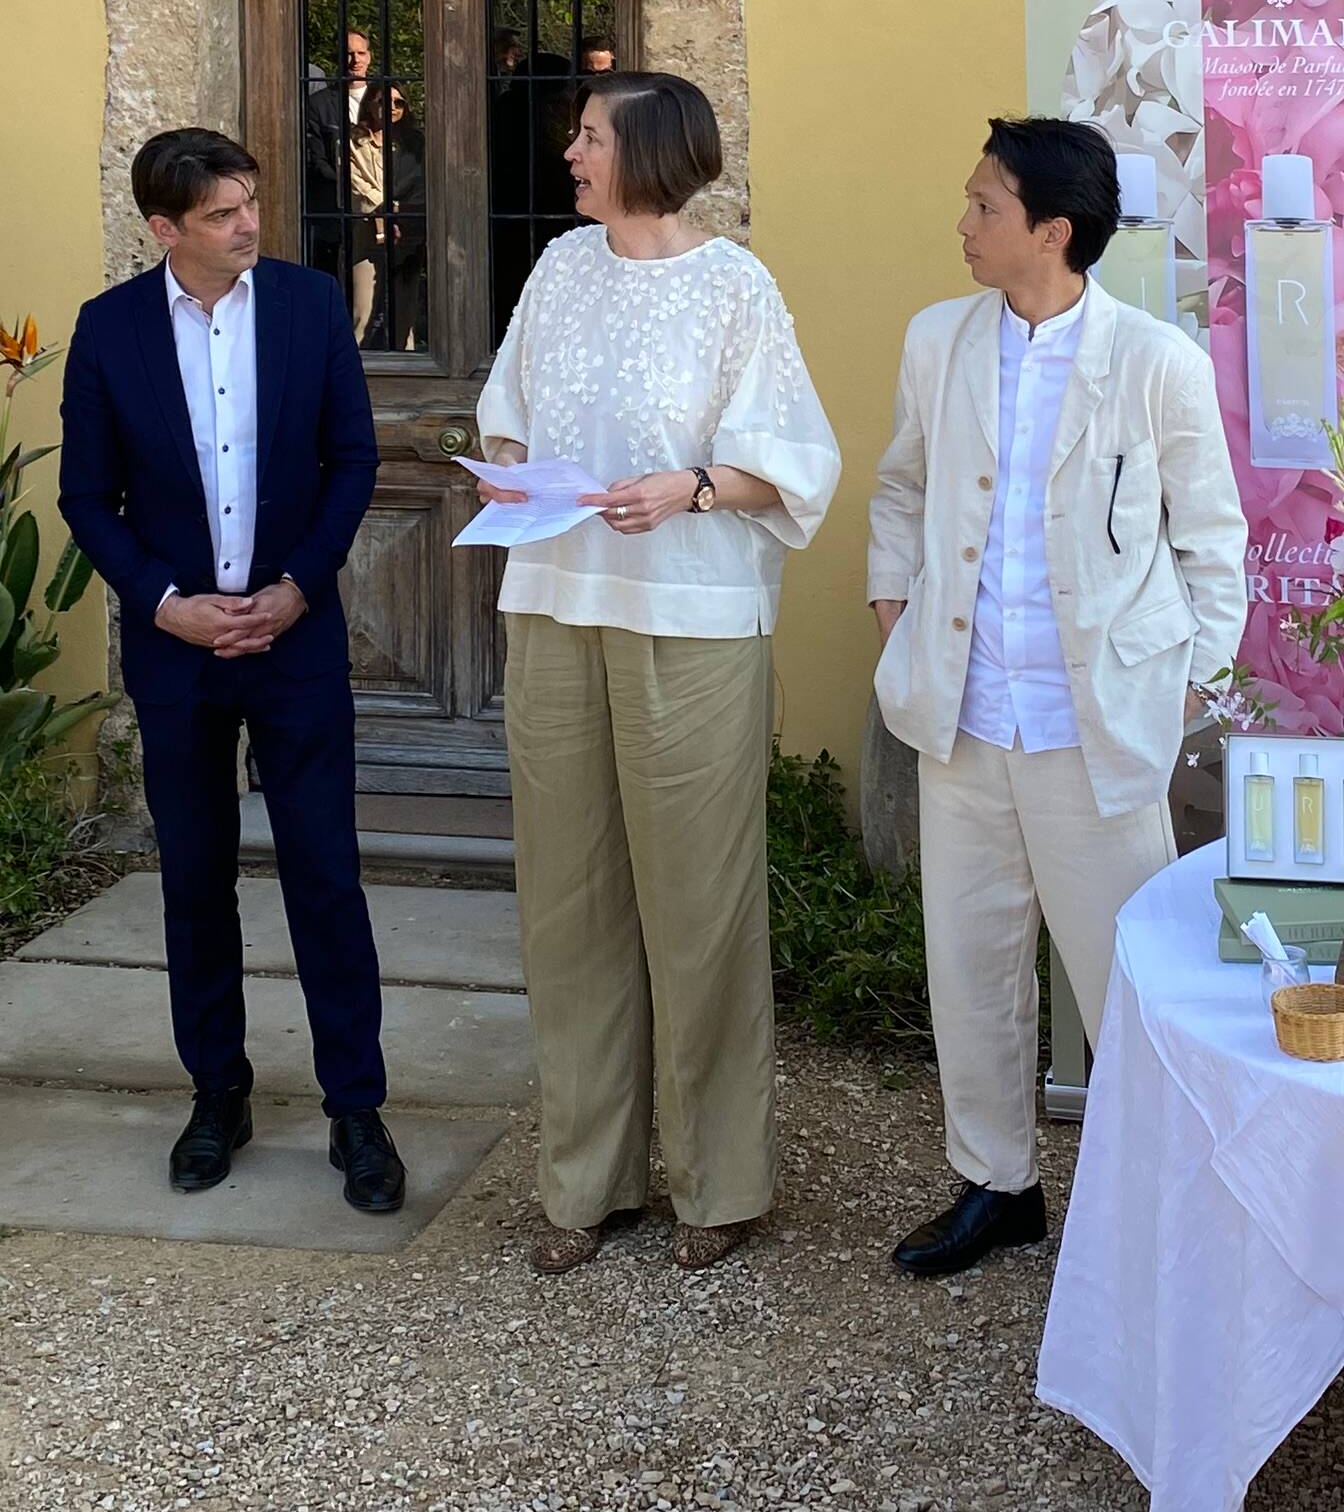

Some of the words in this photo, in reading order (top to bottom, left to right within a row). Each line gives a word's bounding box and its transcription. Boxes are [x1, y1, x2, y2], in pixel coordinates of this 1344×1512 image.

[1203, 56, 1266, 74] Maison
[1269, 58, 1286, 73] de
[1220, 78, 1273, 100] fondée
[1278, 84, 1297, 96] en
[1247, 533, 1331, 565] ollecti
[1303, 796, 1313, 814] R
